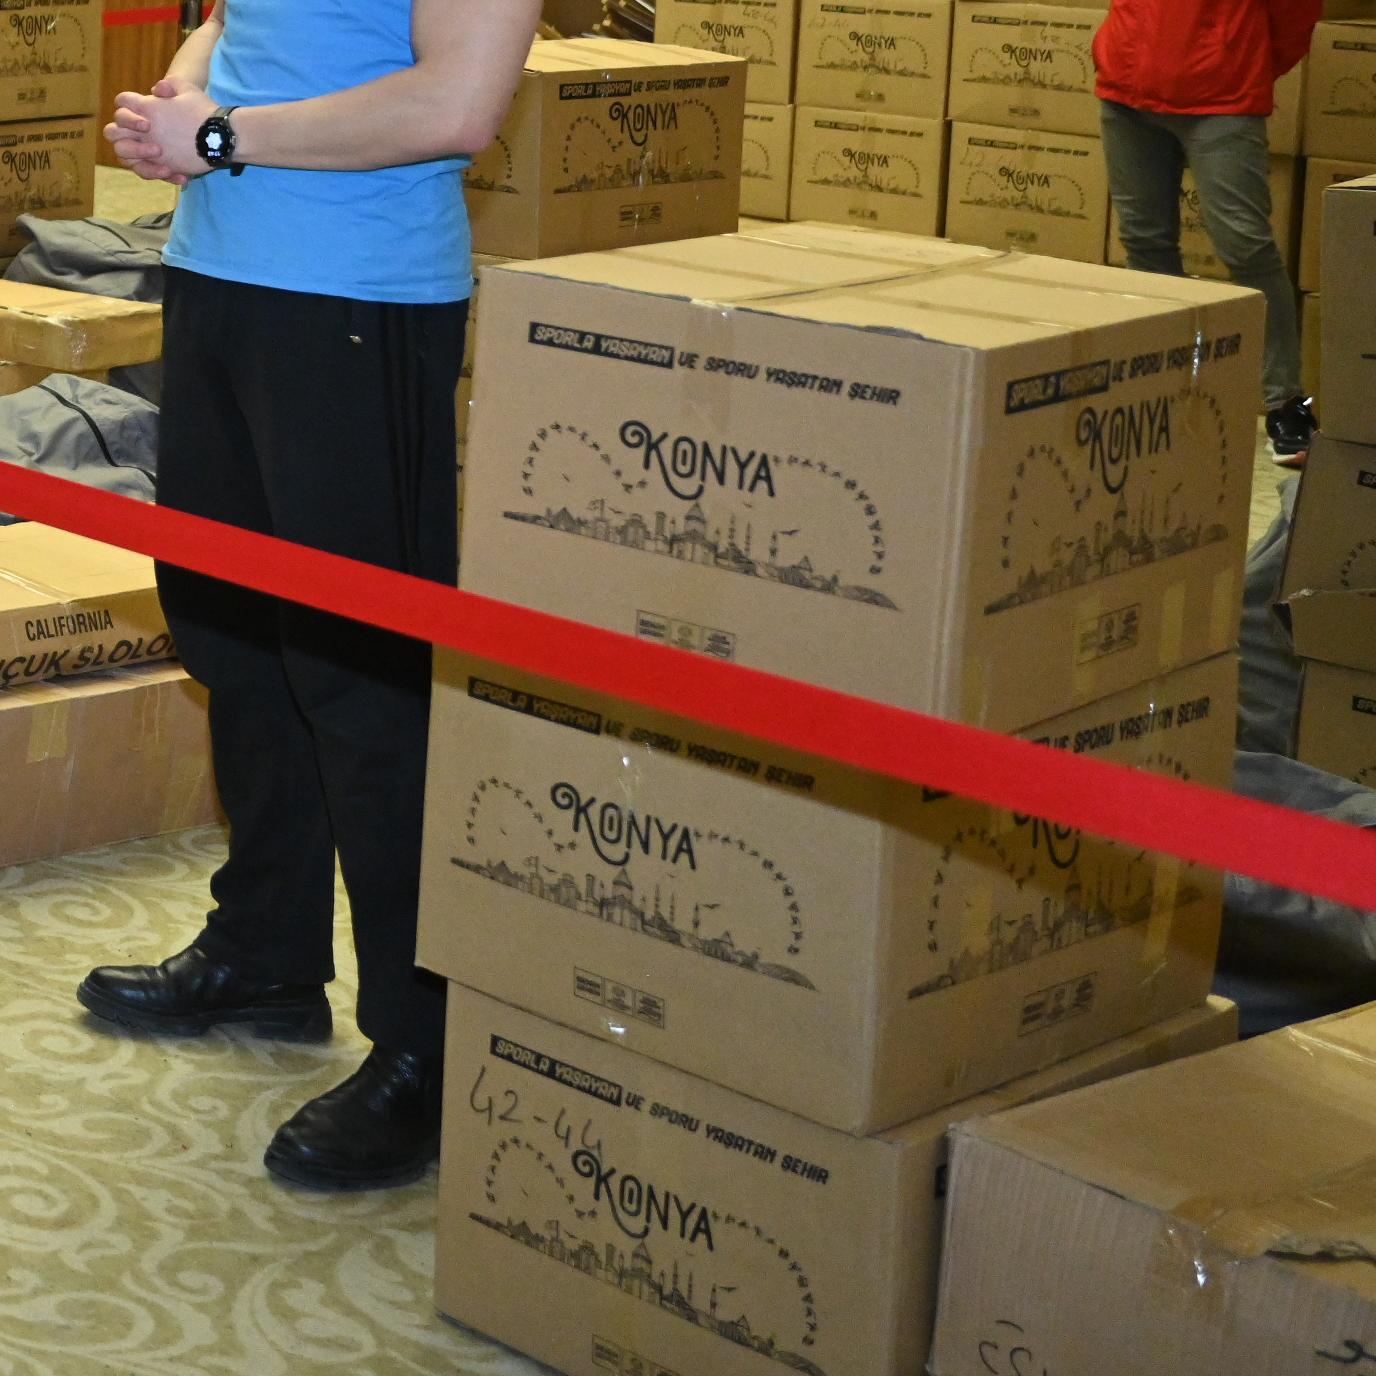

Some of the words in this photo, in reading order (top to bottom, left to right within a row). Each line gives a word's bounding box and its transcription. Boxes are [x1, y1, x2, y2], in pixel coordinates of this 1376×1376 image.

[10, 14, 56, 46] KONYA
[701, 20, 745, 43] KONYA
[849, 31, 896, 55] KONYA
[1002, 43, 1053, 68] KONYA
[609, 101, 678, 146] KONYA
[2, 150, 51, 182] KONYA
[842, 147, 889, 172] KONYA
[533, 326, 595, 350] SPORLA
[600, 337, 671, 366] YAŞAYAN
[703, 356, 759, 379] SPORU
[764, 367, 843, 395] YAŞATAN
[619, 420, 775, 500] KONYA
[1075, 396, 1171, 494] KONYA
[25, 609, 114, 641] CALIFORNIA
[72, 634, 177, 670] SLOLO
[473, 680, 528, 712] SPORLA
[629, 727, 682, 753] SPORU
[687, 742, 760, 778] YAŞATAN
[1074, 724, 1114, 753] SPORU
[551, 782, 696, 870] KONYA
[495, 1039, 549, 1072] SPORLA
[554, 1060, 620, 1100] YAŞAYAN
[649, 1102, 701, 1134] SPORU
[705, 1122, 777, 1164] YAŞATAN
[572, 1149, 713, 1251] KONYA
